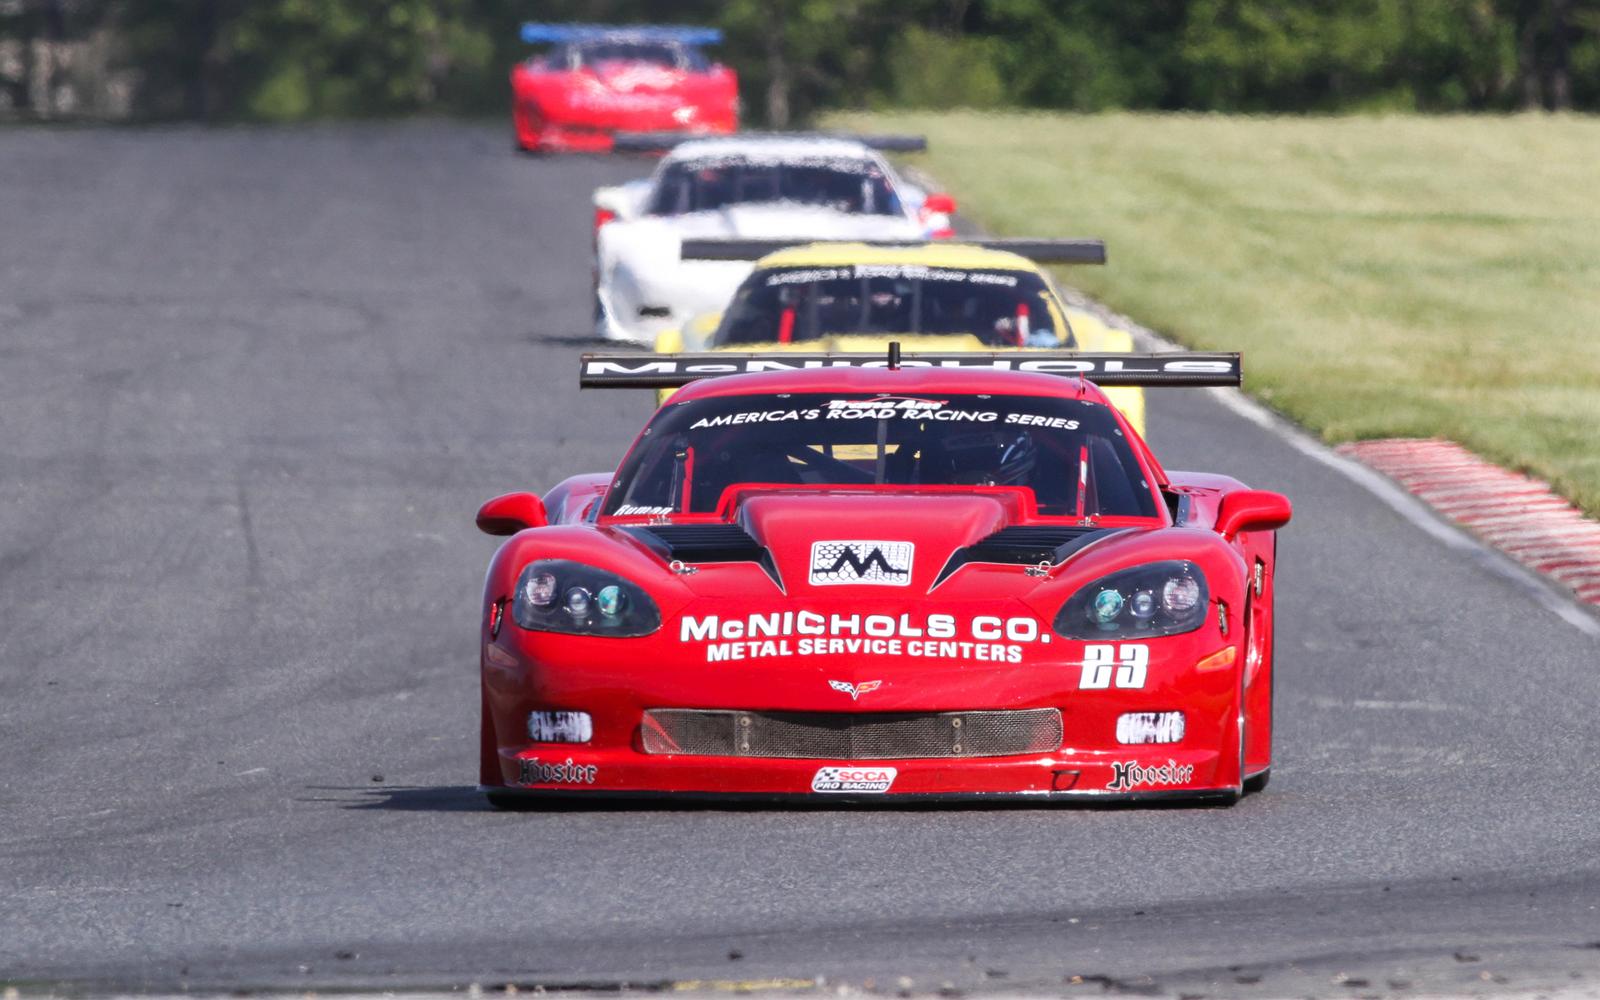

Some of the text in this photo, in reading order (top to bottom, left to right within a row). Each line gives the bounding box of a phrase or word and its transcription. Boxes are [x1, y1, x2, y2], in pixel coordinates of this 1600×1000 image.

[690, 409, 1081, 430] AMERICA'S ROAD RACING SERIES
[680, 610, 1051, 644] McNICHOLS CO.
[707, 638, 1023, 663] METAL SERVICE CENTERS
[1079, 643, 1150, 690] 23
[518, 757, 598, 785] Hoosier
[838, 771, 889, 781] SCCA
[1106, 759, 1194, 790] Hoosier
[815, 782, 887, 790] PRO RACING
